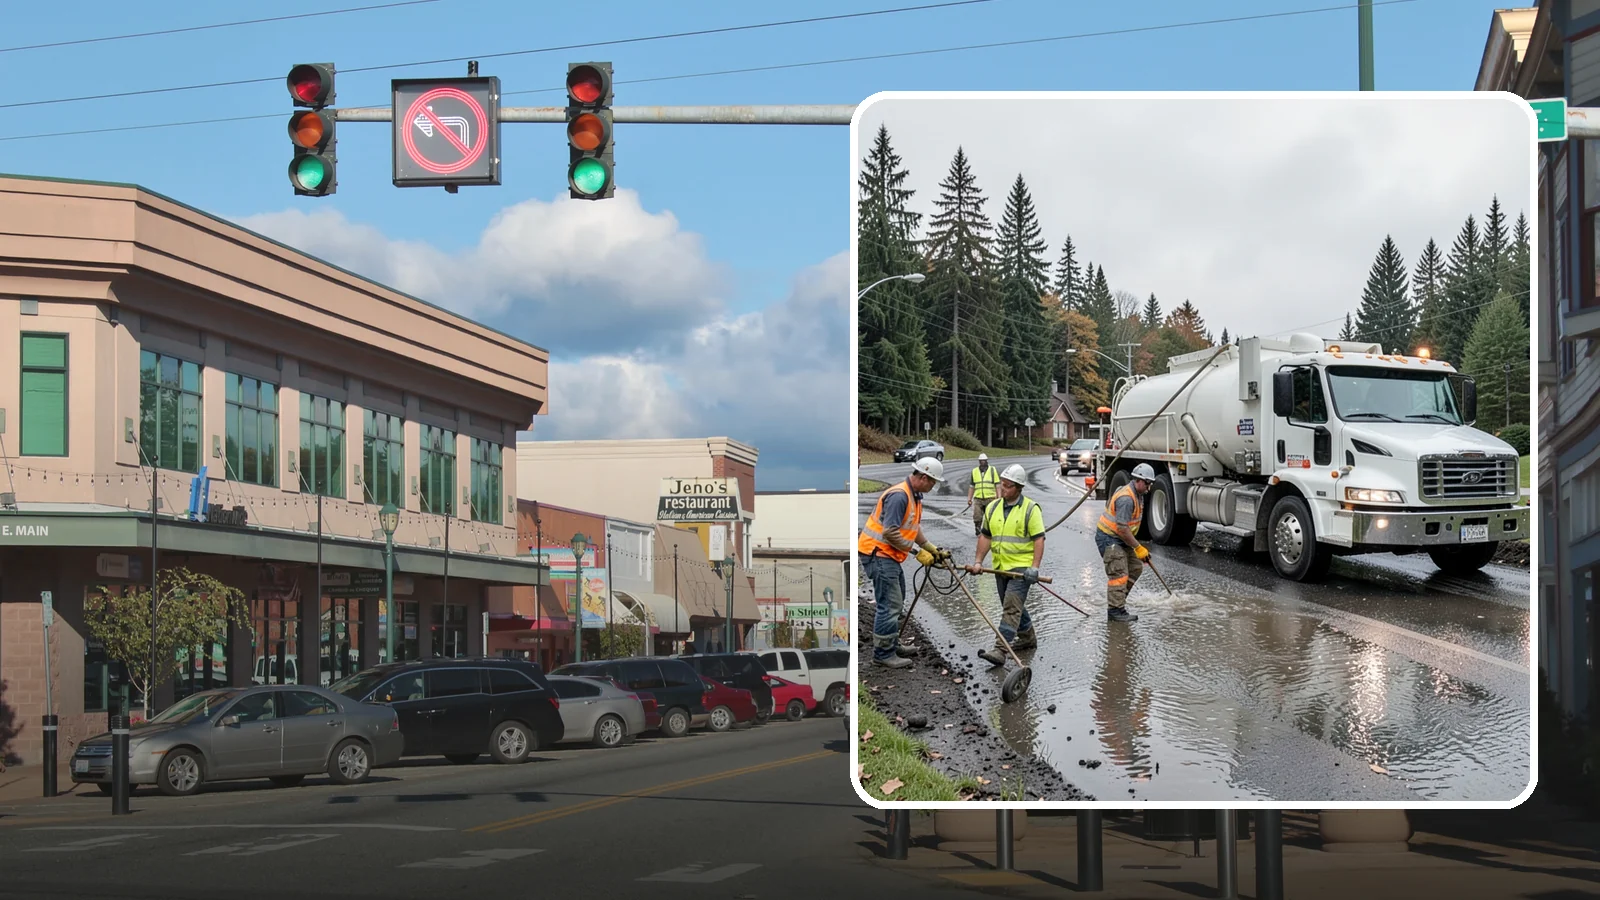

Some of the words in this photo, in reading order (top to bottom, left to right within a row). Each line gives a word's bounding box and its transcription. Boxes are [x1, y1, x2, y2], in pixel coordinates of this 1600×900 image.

[669, 480, 727, 494] Jeno's
[665, 496, 731, 509] restaurant
[658, 510, 682, 519] Italian
[686, 510, 715, 519] American
[715, 510, 738, 519] Cuisine
[2, 525, 13, 536] E.
[15, 525, 49, 536] MAIN
[797, 608, 828, 617] Street
[791, 619, 823, 627] lass
